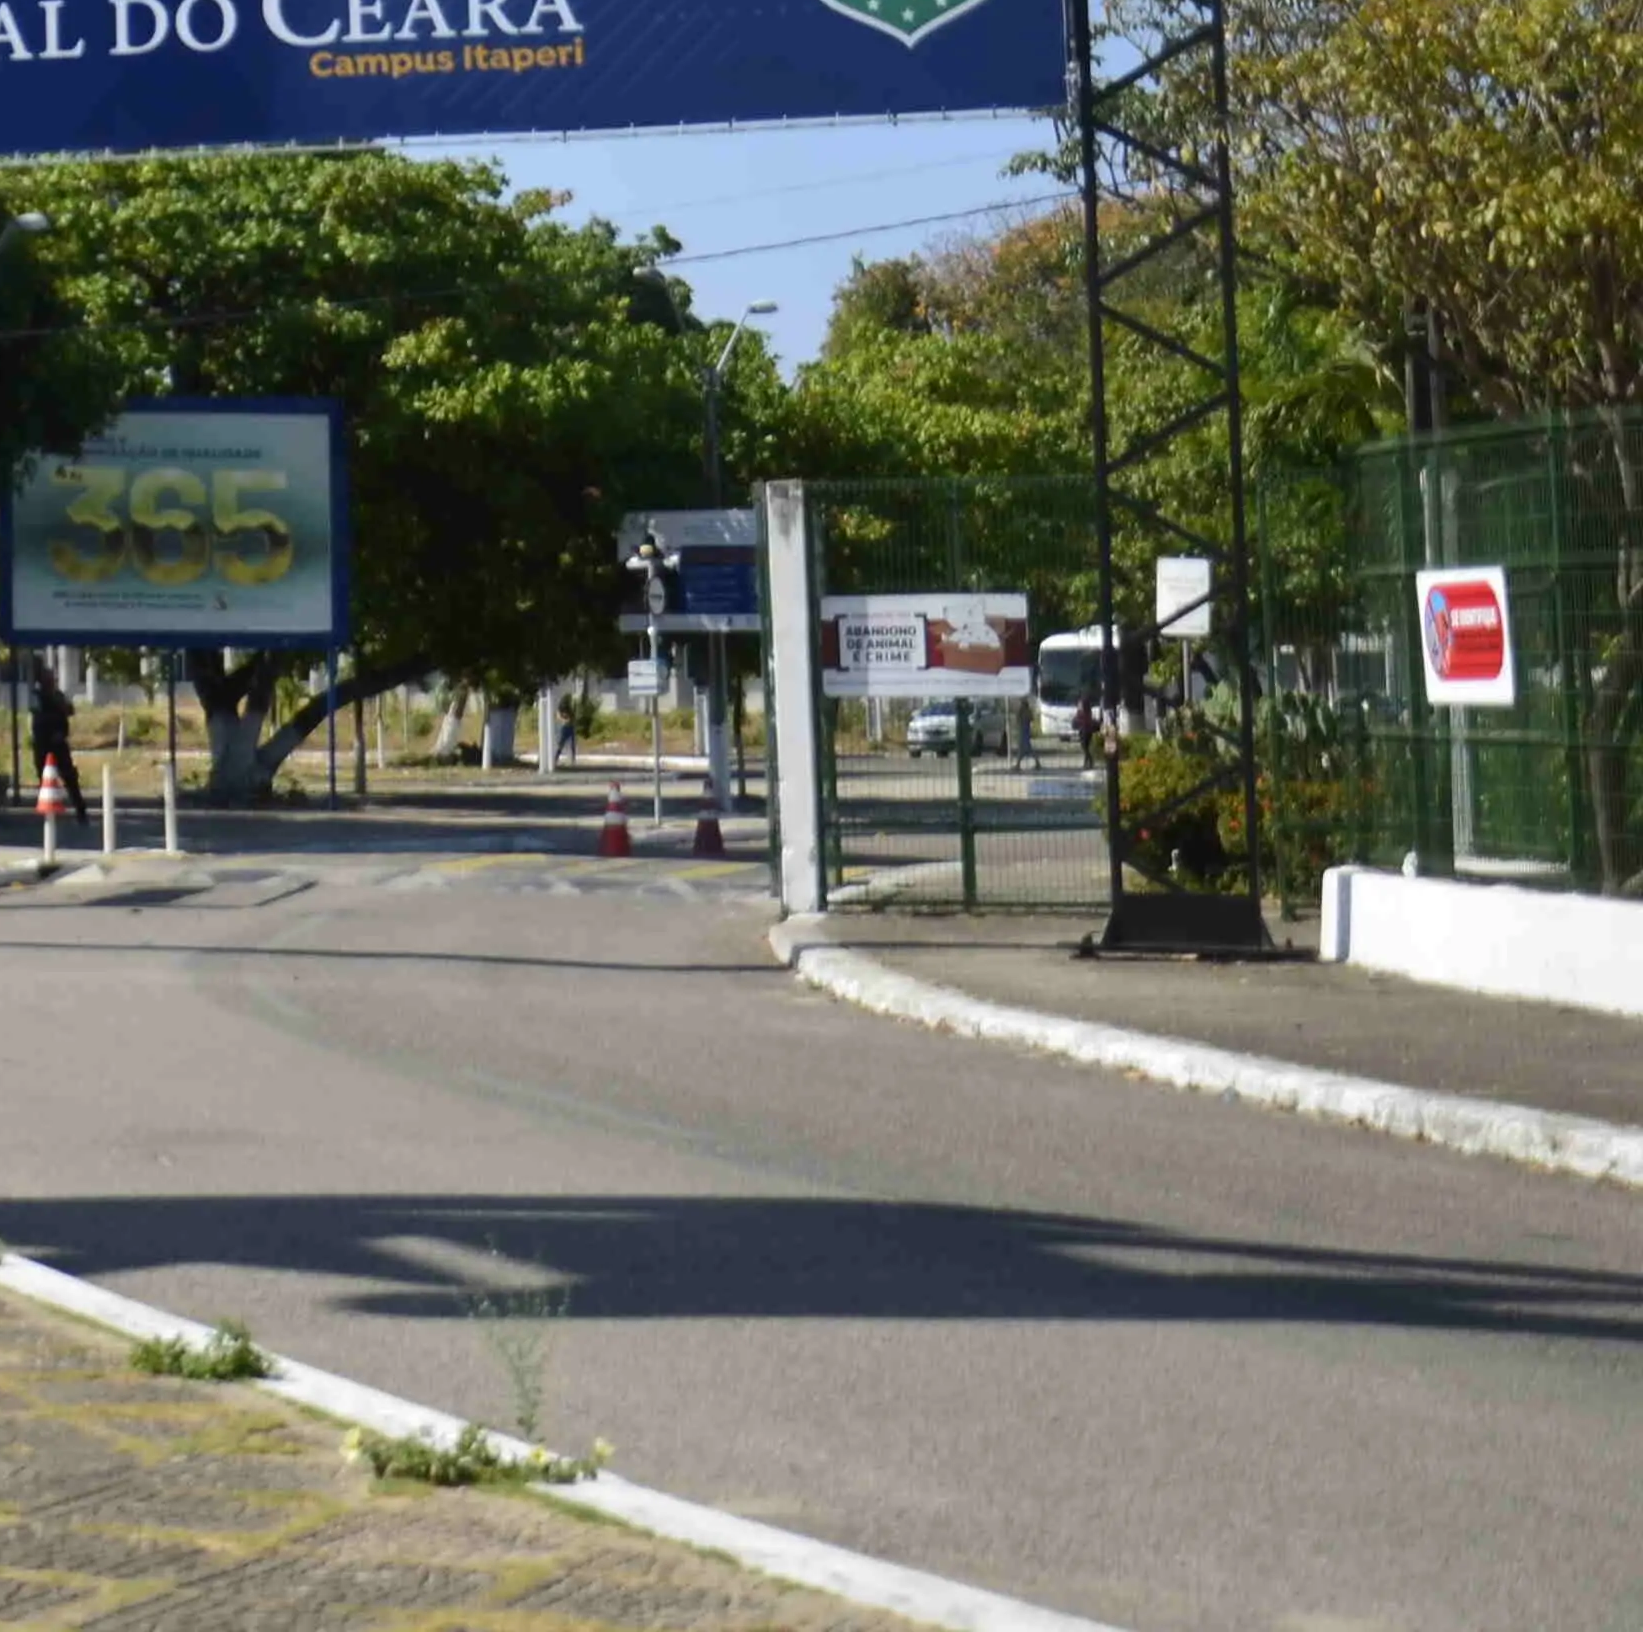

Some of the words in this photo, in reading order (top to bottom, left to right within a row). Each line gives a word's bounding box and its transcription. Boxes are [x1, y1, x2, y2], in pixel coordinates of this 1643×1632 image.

[309, 48, 455, 79] Campus
[463, 37, 585, 73] Itaperi
[48, 466, 293, 587] 365
[845, 625, 917, 636] ABANDONO
[846, 638, 862, 649] DE
[867, 638, 915, 649] ANIMAL
[866, 651, 911, 662] CRIME
